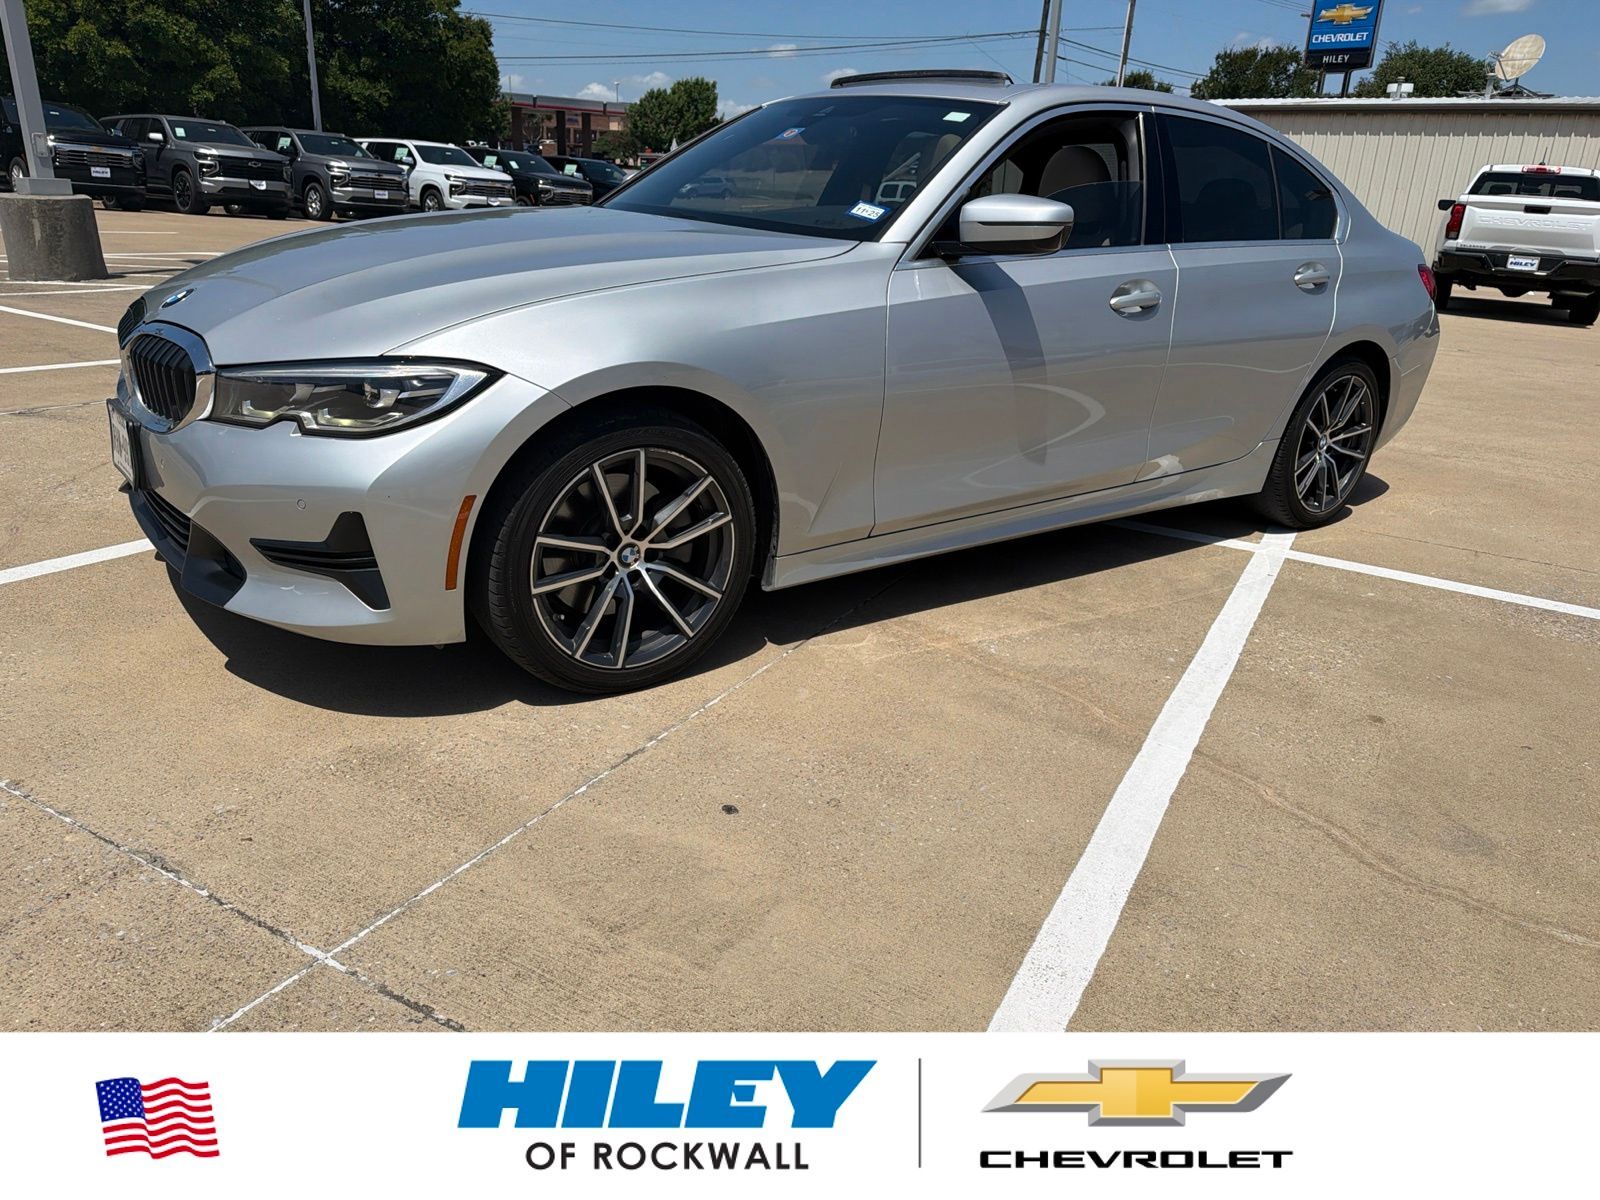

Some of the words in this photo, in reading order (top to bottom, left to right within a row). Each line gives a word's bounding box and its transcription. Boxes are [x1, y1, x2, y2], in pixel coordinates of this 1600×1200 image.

[1312, 32, 1369, 43] CHEVROLET
[1323, 55, 1350, 63] HILEY
[1479, 215, 1593, 230] CHEVROLET
